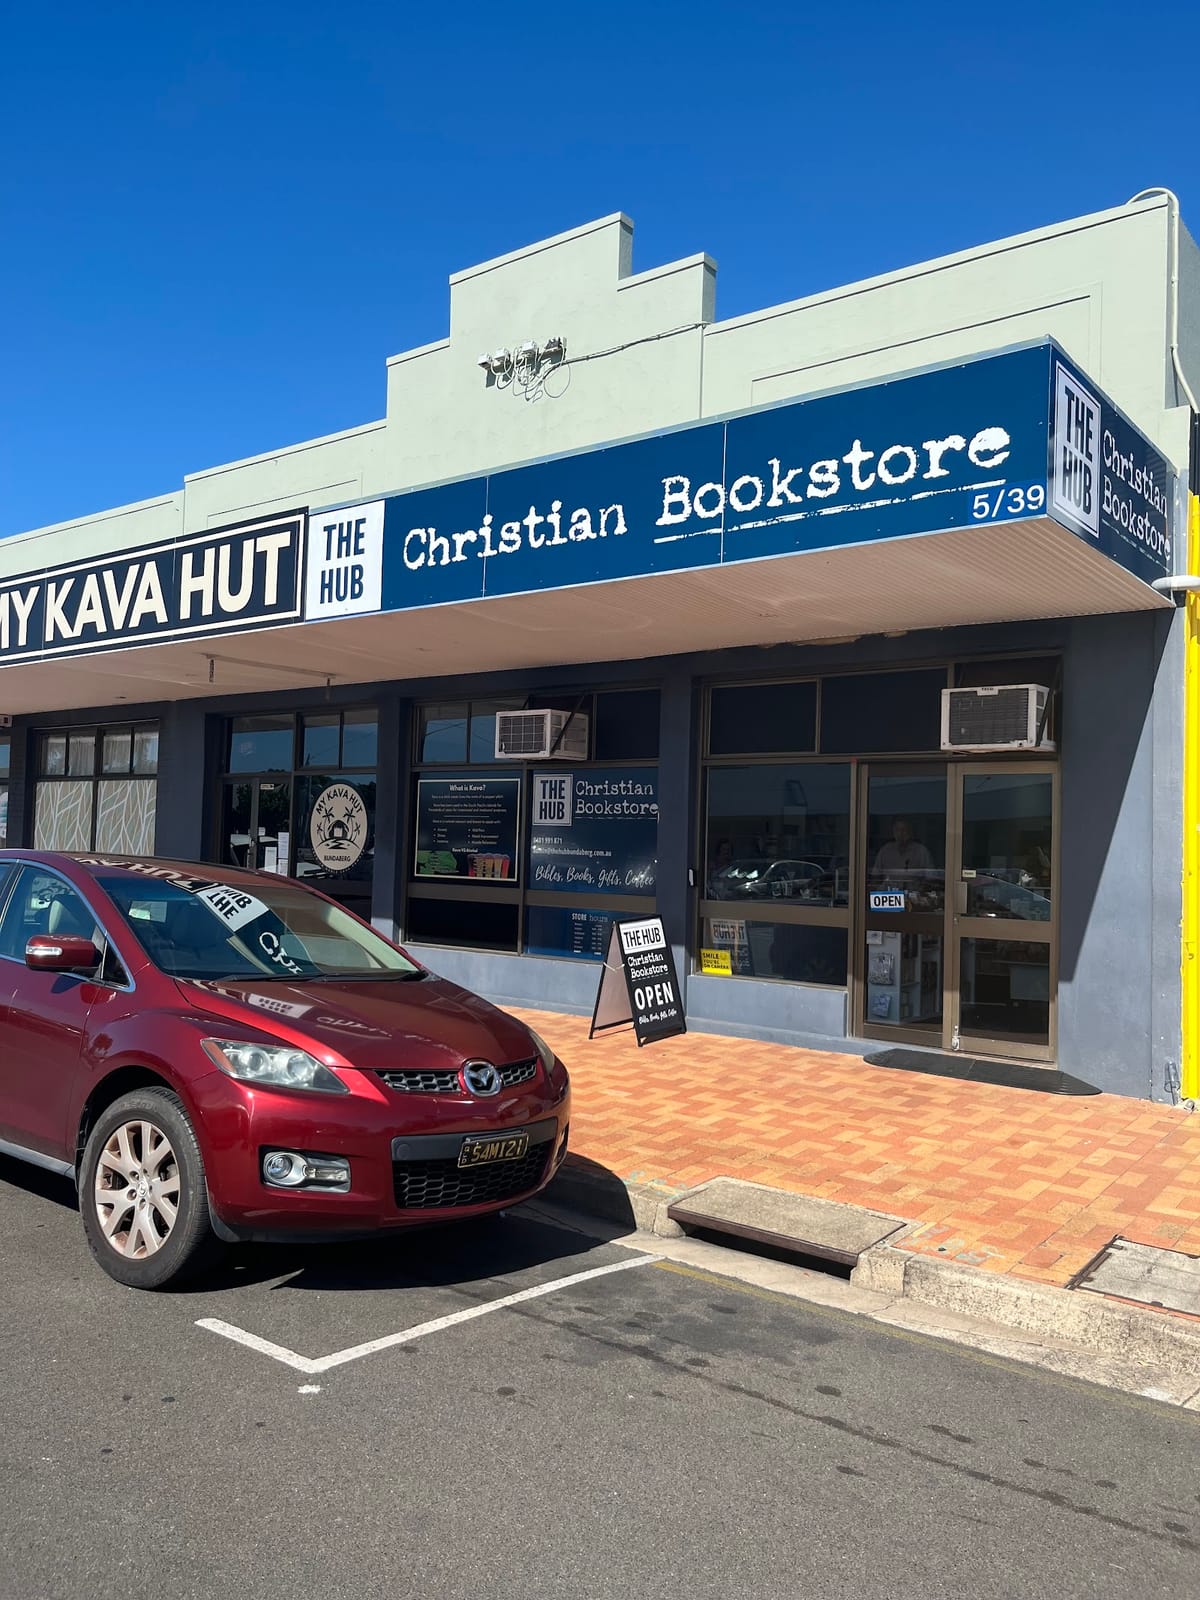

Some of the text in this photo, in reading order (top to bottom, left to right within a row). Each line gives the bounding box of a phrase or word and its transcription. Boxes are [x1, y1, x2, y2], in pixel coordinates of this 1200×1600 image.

[1065, 385, 1094, 463] THE
[1062, 446, 1093, 516] HUB
[1102, 429, 1168, 519] Christian
[403, 426, 1011, 570] Christian Bookstore
[972, 484, 1045, 521] 5/39
[1102, 474, 1171, 561] Bookstore
[322, 518, 367, 561] THE
[45, 561, 168, 642] KAVA
[179, 531, 292, 620] HUT
[319, 563, 365, 604] HUB
[316, 788, 363, 815] MY KAVA HUT
[540, 780, 566, 799] THE
[575, 780, 654, 796] Christian
[539, 801, 565, 820] HUB
[575, 798, 659, 815] Bookstore
[874, 895, 902, 907] OPEN
[571, 912, 587, 921] STORE
[623, 930, 642, 948] THE
[641, 927, 661, 946] HUB
[627, 952, 664, 967] Christian
[630, 964, 669, 979] Bookstore
[634, 981, 674, 1010] OPEN
